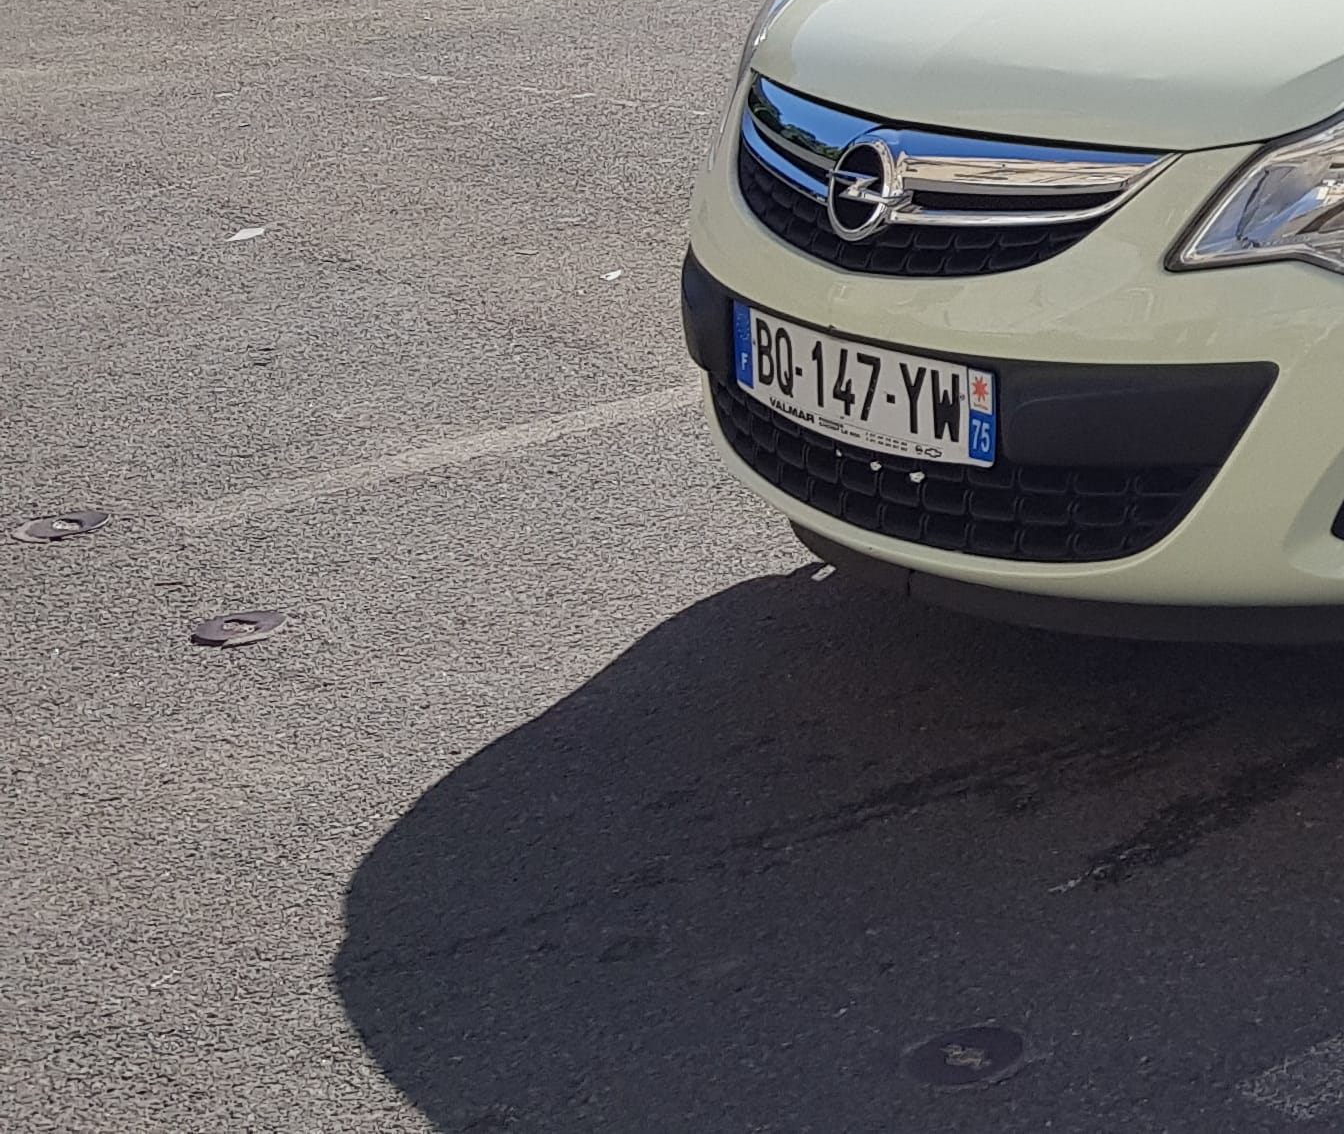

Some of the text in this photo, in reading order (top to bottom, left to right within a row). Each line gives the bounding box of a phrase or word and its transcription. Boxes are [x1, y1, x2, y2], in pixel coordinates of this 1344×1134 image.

[740, 352, 749, 371] F
[755, 317, 961, 443] BQ-147-YW
[769, 396, 815, 424] VALMAR
[972, 418, 990, 453] 75
